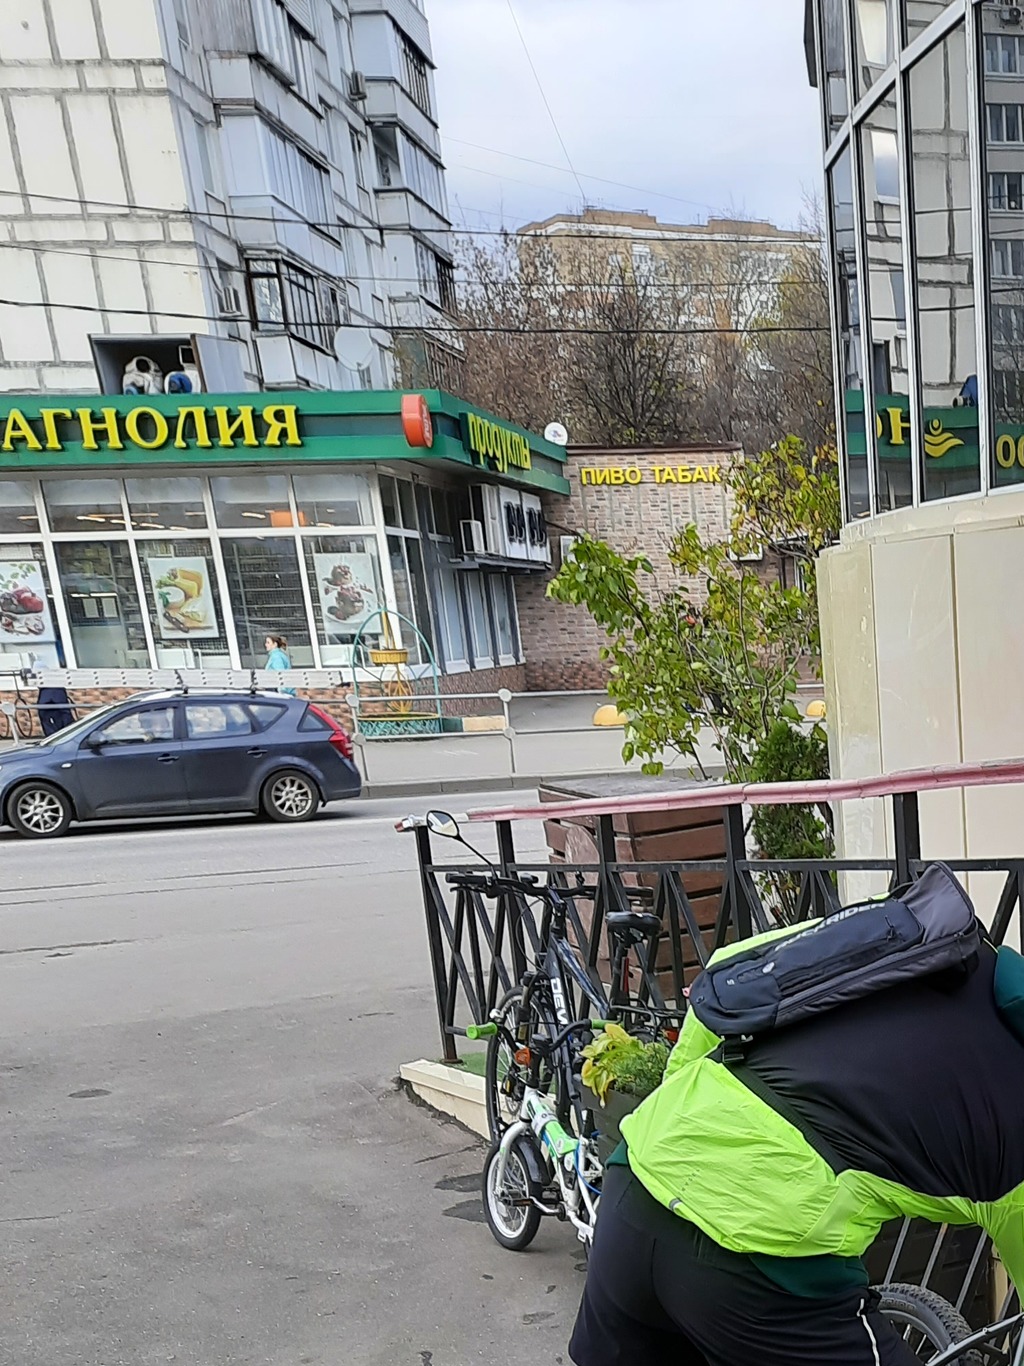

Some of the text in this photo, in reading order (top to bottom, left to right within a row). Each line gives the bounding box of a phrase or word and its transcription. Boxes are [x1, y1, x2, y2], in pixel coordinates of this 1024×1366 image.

[2, 405, 302, 450] АГНОЛИЯ
[467, 412, 532, 474] продукты
[581, 464, 723, 485] ПИВО ТАБАК
